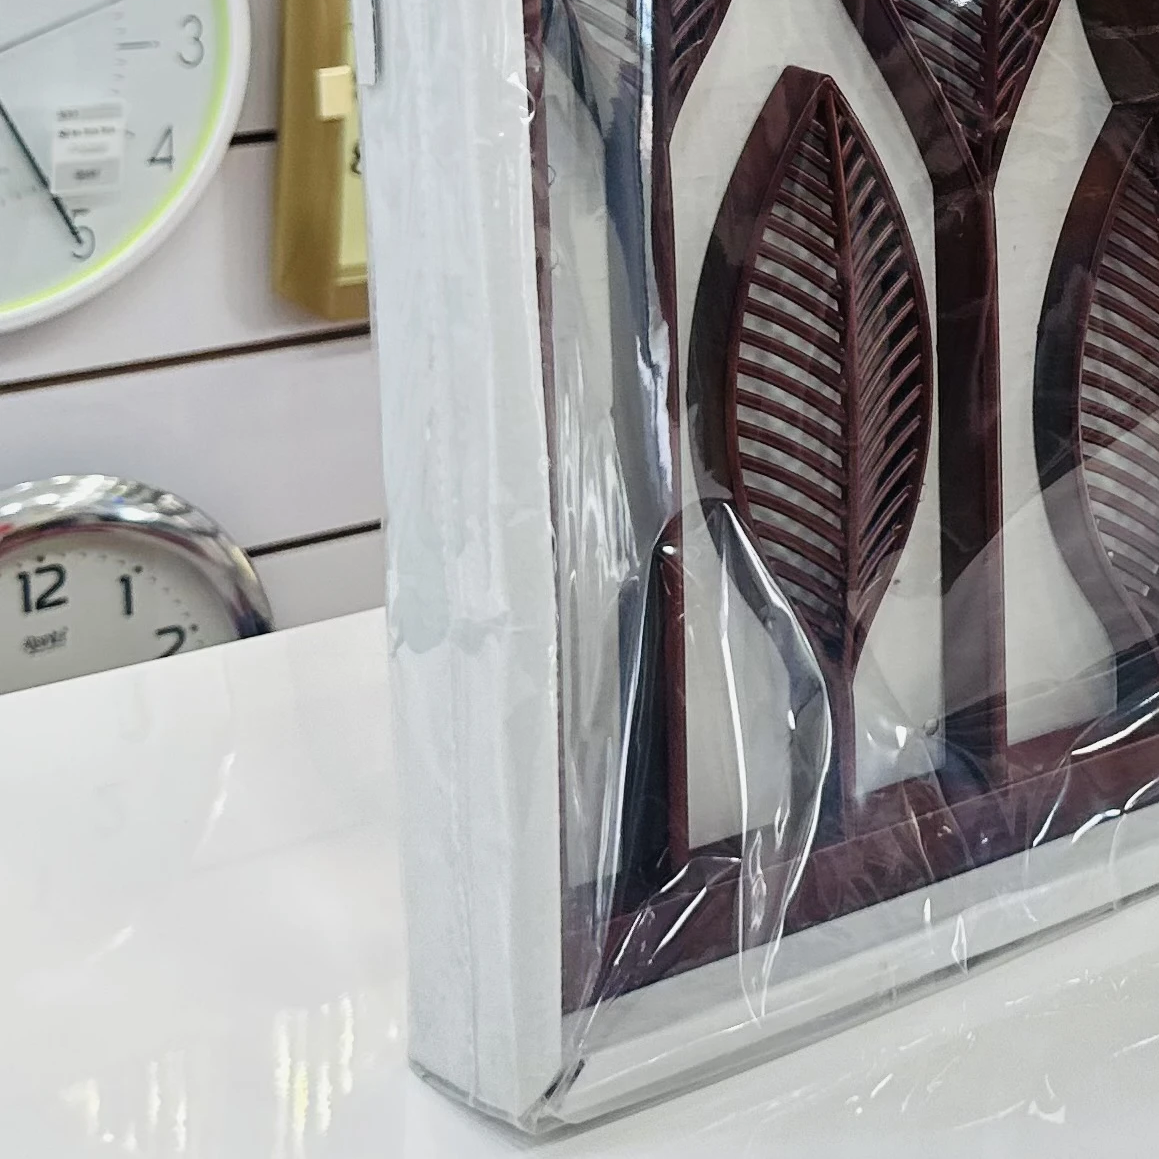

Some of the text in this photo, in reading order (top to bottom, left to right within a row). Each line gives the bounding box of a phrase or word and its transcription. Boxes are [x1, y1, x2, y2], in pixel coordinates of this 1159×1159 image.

[178, 13, 205, 69] 3
[146, 124, 174, 172] 4
[18, 563, 68, 614] 12
[119, 574, 134, 617] 1
